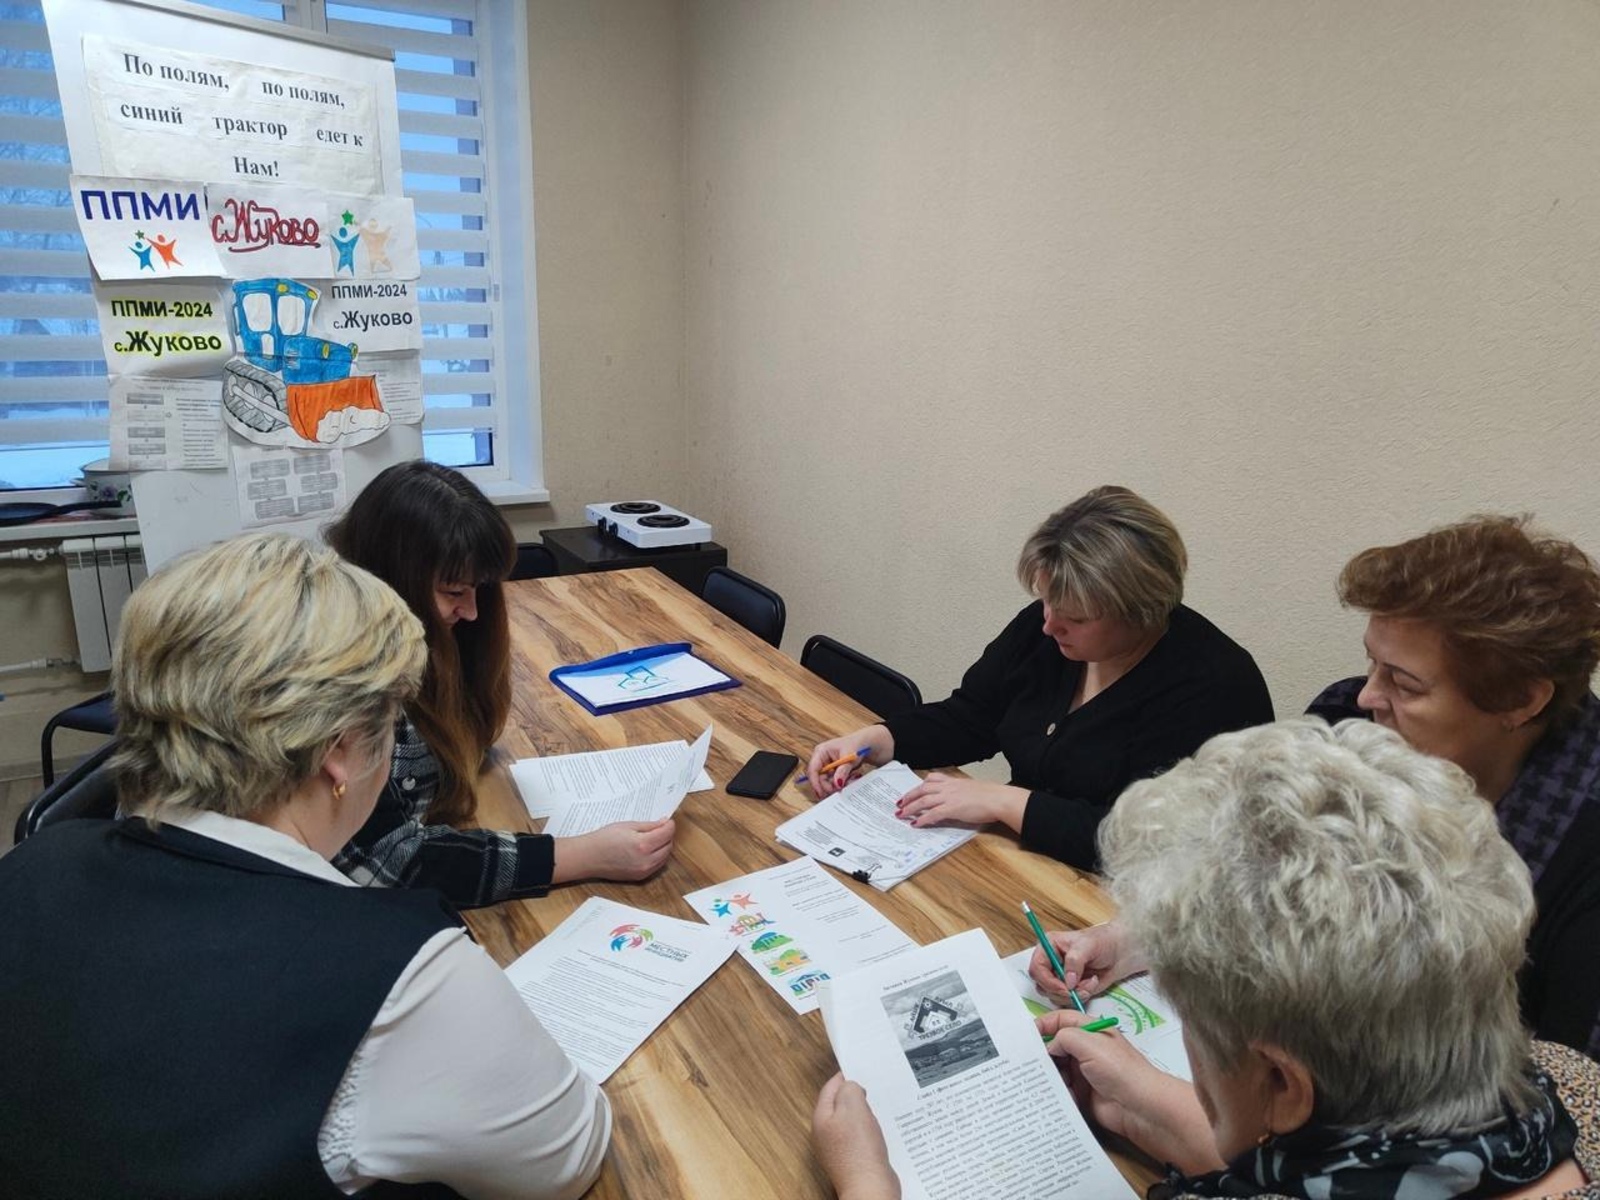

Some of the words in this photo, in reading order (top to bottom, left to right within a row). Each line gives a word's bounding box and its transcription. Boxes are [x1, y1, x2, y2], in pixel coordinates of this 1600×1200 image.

[123, 53, 153, 77] По
[160, 65, 230, 91] полям,
[262, 81, 284, 97] по
[289, 87, 345, 108] полям,
[120, 104, 183, 125] синий
[214, 116, 288, 141] трактор
[316, 129, 348, 146] едет
[353, 134, 363, 147] к
[233, 156, 279, 177] Нам!
[80, 190, 200, 220] ППМИ
[331, 284, 407, 299] ППМИ-2024
[111, 300, 213, 318] ППМИ-2024
